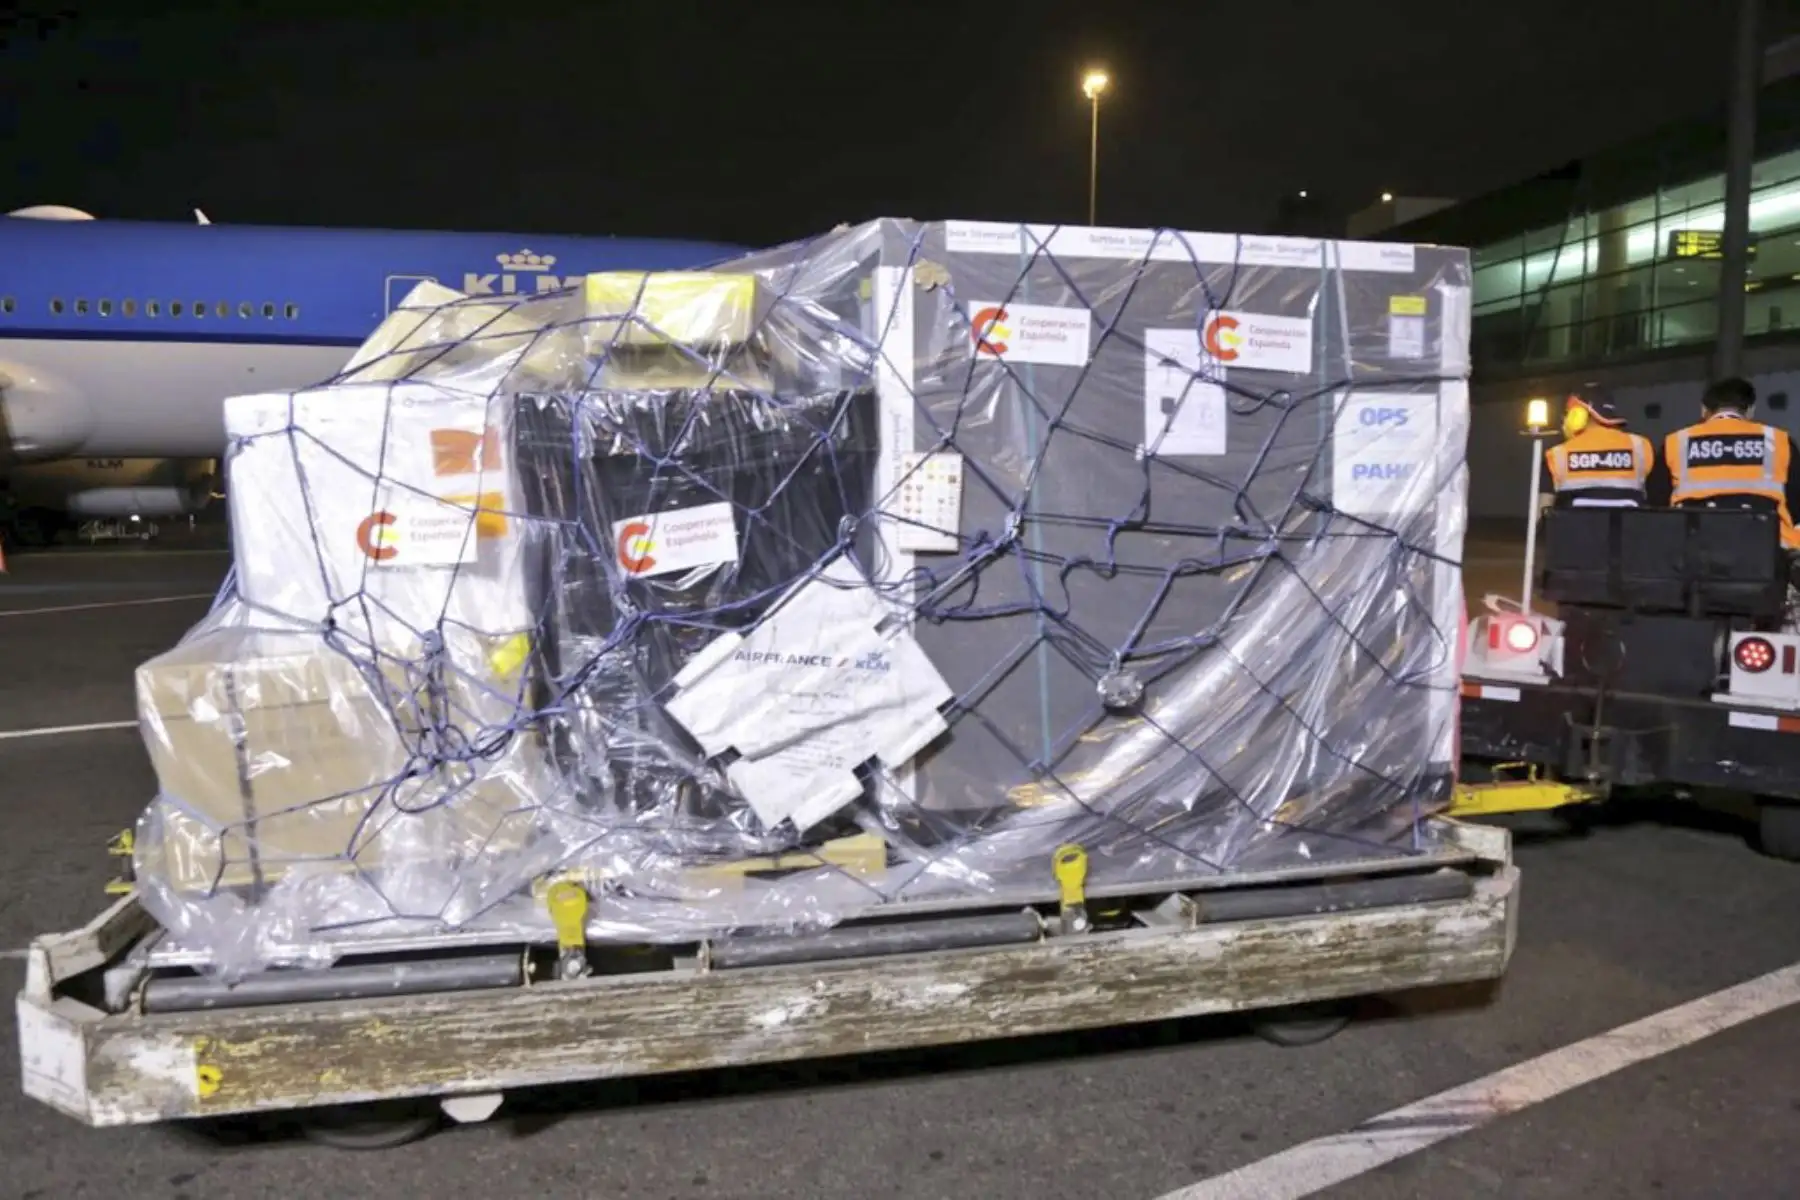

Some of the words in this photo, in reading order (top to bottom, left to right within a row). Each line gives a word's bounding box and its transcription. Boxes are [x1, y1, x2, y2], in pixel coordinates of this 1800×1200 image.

[1359, 407, 1409, 426] OPS
[1688, 439, 1764, 460] ASG-655
[1569, 452, 1632, 470] SGP-409
